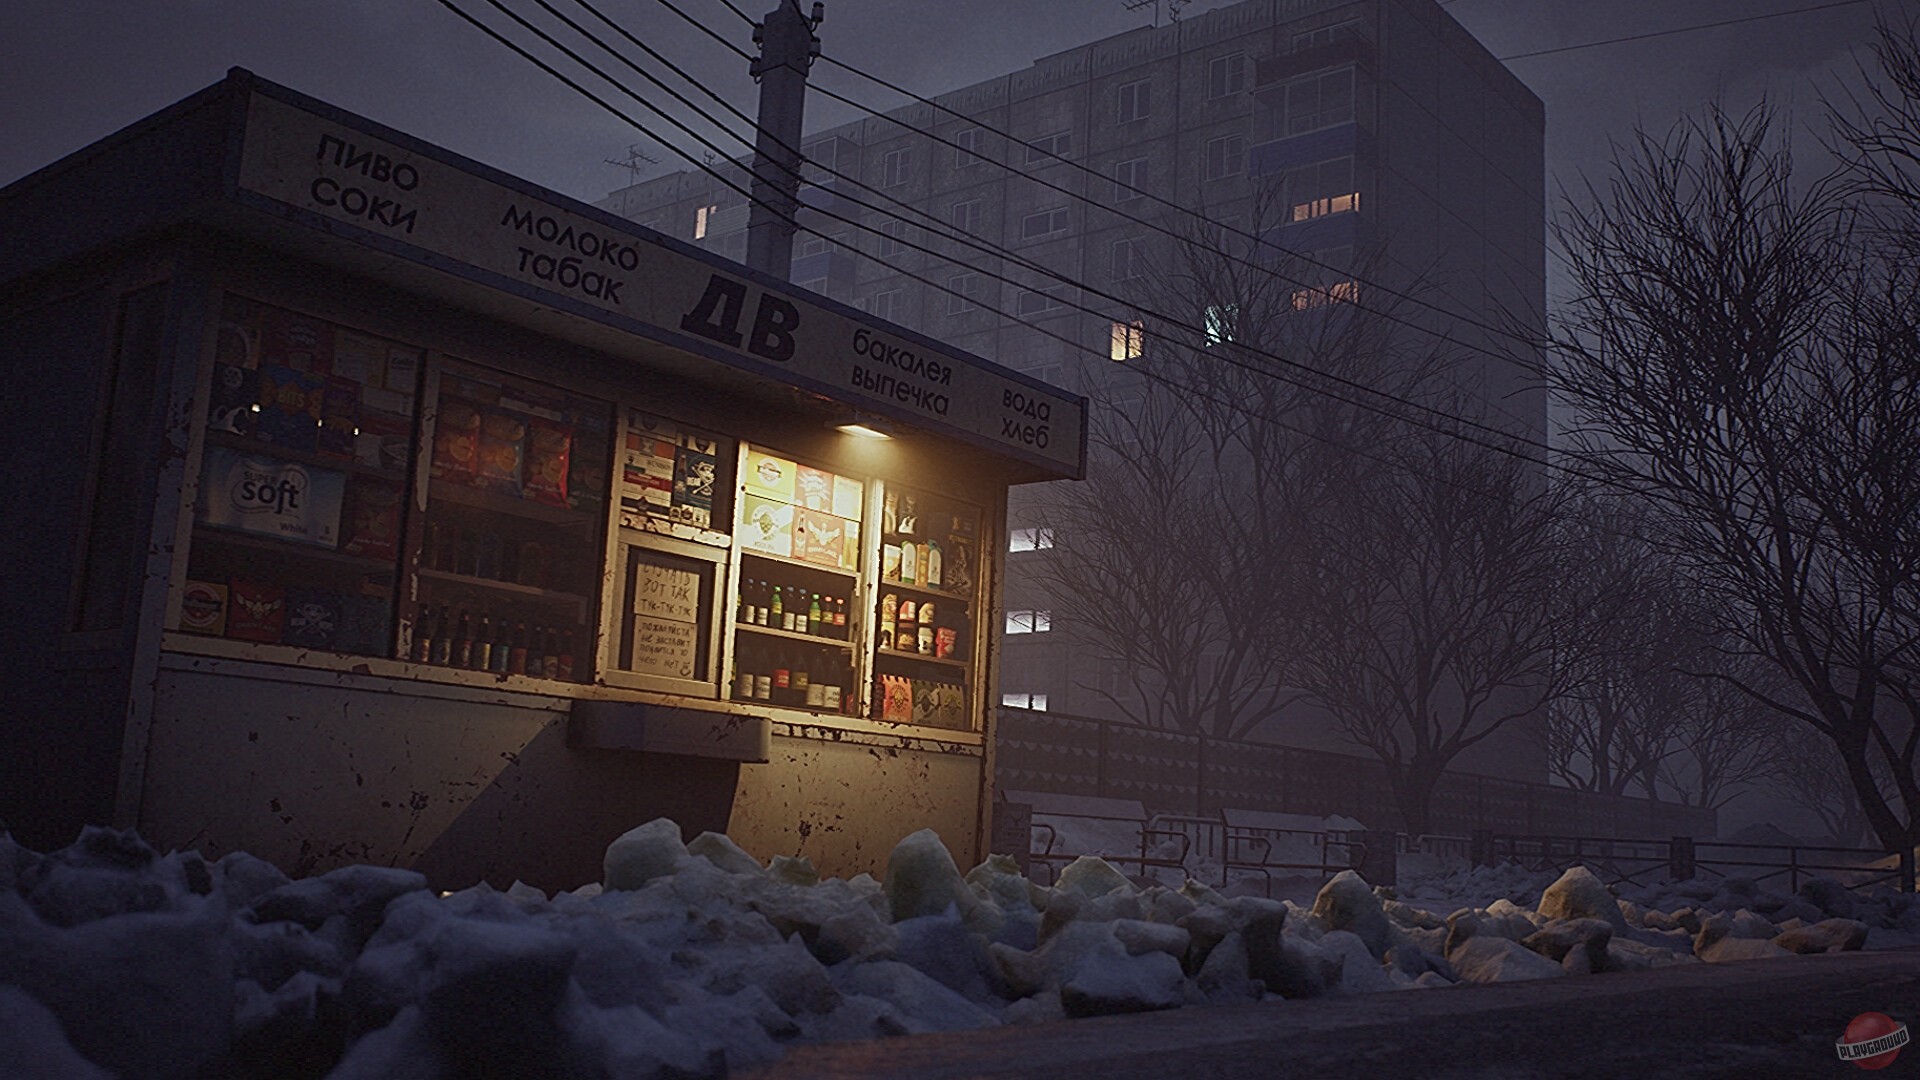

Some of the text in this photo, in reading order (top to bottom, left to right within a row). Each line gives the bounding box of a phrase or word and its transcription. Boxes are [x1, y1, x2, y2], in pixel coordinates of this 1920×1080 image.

[517, 245, 624, 304] табак
[679, 273, 800, 362] ДВ
[852, 328, 952, 386] бакалея
[851, 365, 949, 417] выпечка
[1002, 388, 1052, 422] вода
[1001, 415, 1050, 450] хлеб
[243, 471, 277, 485] SUPER
[241, 479, 299, 514] soft
[280, 522, 308, 534] White
